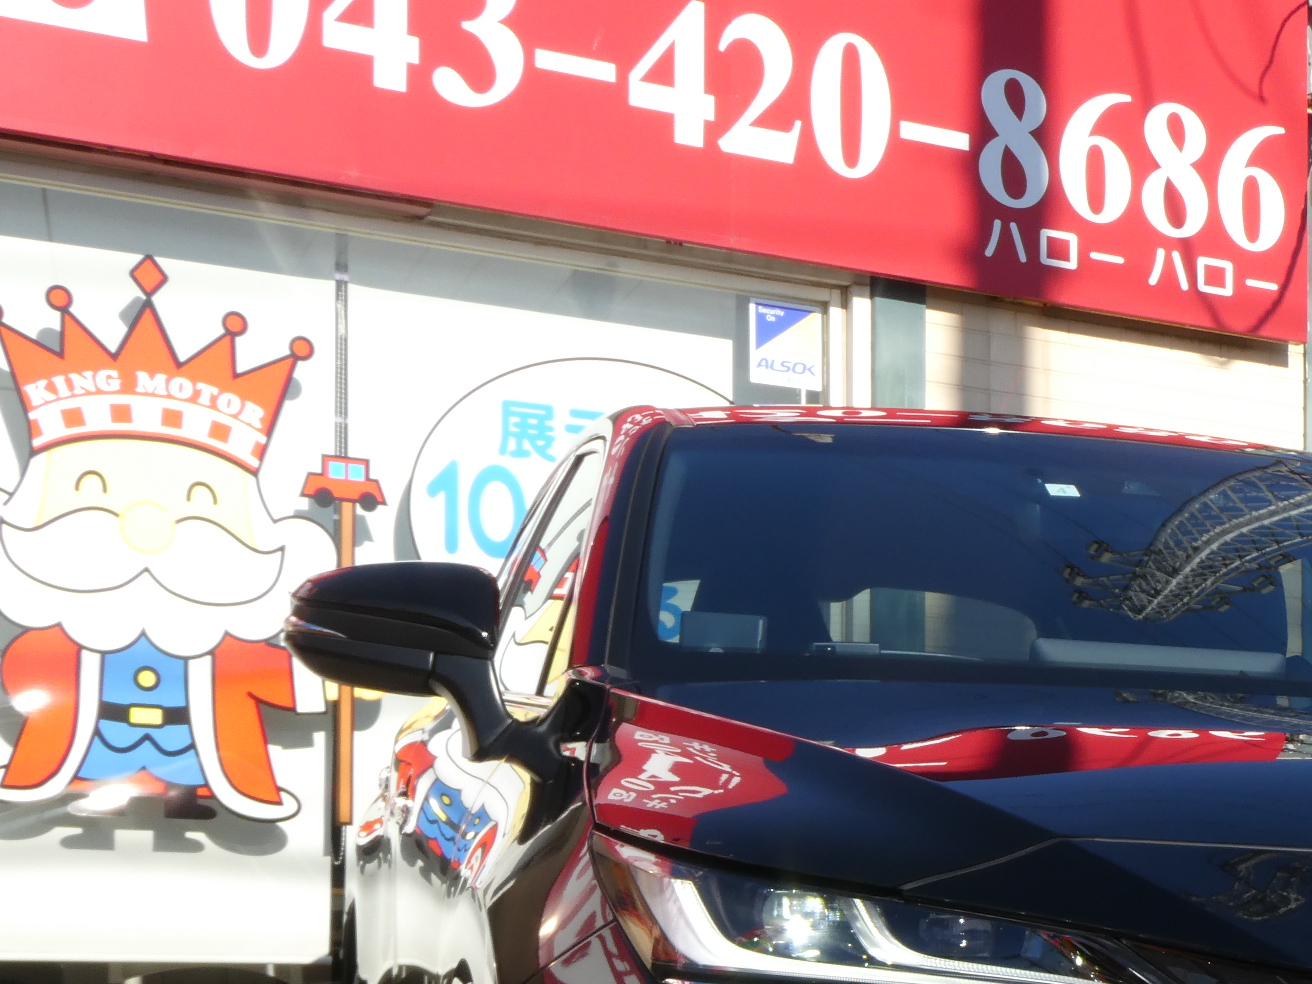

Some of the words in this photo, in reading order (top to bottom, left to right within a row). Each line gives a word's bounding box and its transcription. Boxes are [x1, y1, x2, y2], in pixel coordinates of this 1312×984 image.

[985, 219, 1125, 270] ハロー
[1148, 248, 1278, 297] ハロー
[758, 305, 785, 317] Security
[766, 314, 776, 322] On
[756, 357, 816, 376] ALSOK
[23, 369, 122, 407] KING
[135, 371, 265, 429] MOTOR
